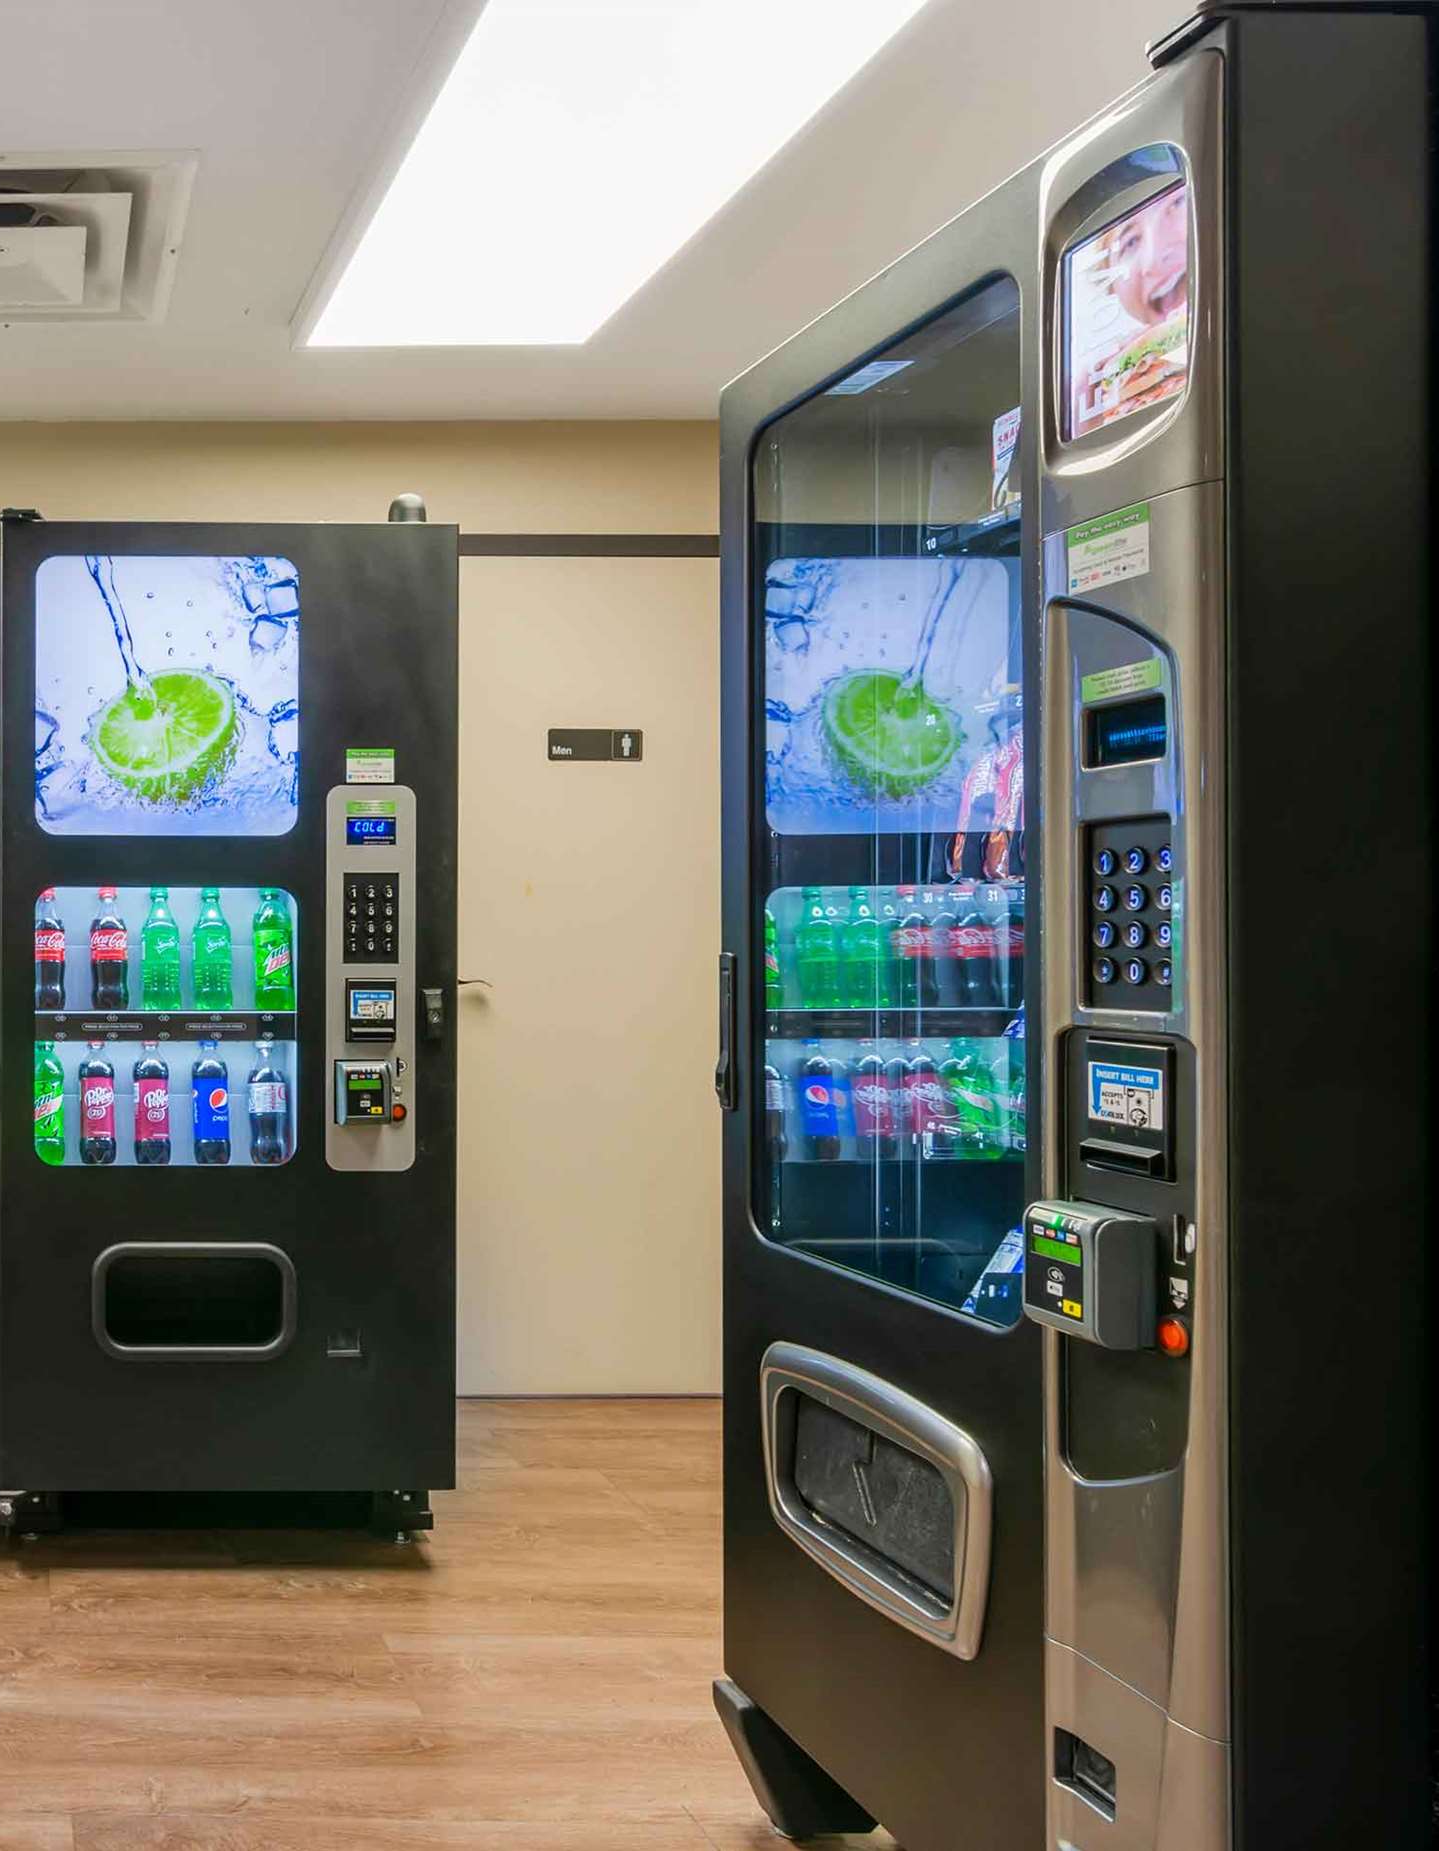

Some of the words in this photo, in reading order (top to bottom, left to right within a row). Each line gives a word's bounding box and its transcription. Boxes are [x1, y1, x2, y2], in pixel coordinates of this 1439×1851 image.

[926, 536, 937, 551] 10
[552, 745, 572, 755] Men
[1100, 855, 1107, 871] 1
[1129, 853, 1138, 869] 2
[1160, 850, 1171, 868] 3
[351, 888, 357, 898] 1
[368, 888, 375, 898] 2
[386, 888, 393, 898] 3
[987, 889, 999, 903] 31
[1099, 890, 1108, 907] 4
[1129, 890, 1139, 907] 5
[1160, 888, 1171, 906] 6
[349, 905, 357, 915] 4
[368, 905, 375, 916] 5
[385, 905, 393, 916] 6
[351, 923, 357, 933] 7
[368, 923, 375, 933] 8
[385, 923, 393, 933] 9
[1100, 927, 1108, 945] 7
[1129, 926, 1139, 944] 8
[1160, 926, 1171, 943] 9
[368, 941, 375, 951] 0
[1129, 963, 1138, 981] 0
[1096, 1068, 1119, 1081] INSERT
[1120, 1073, 1136, 1082] BILL
